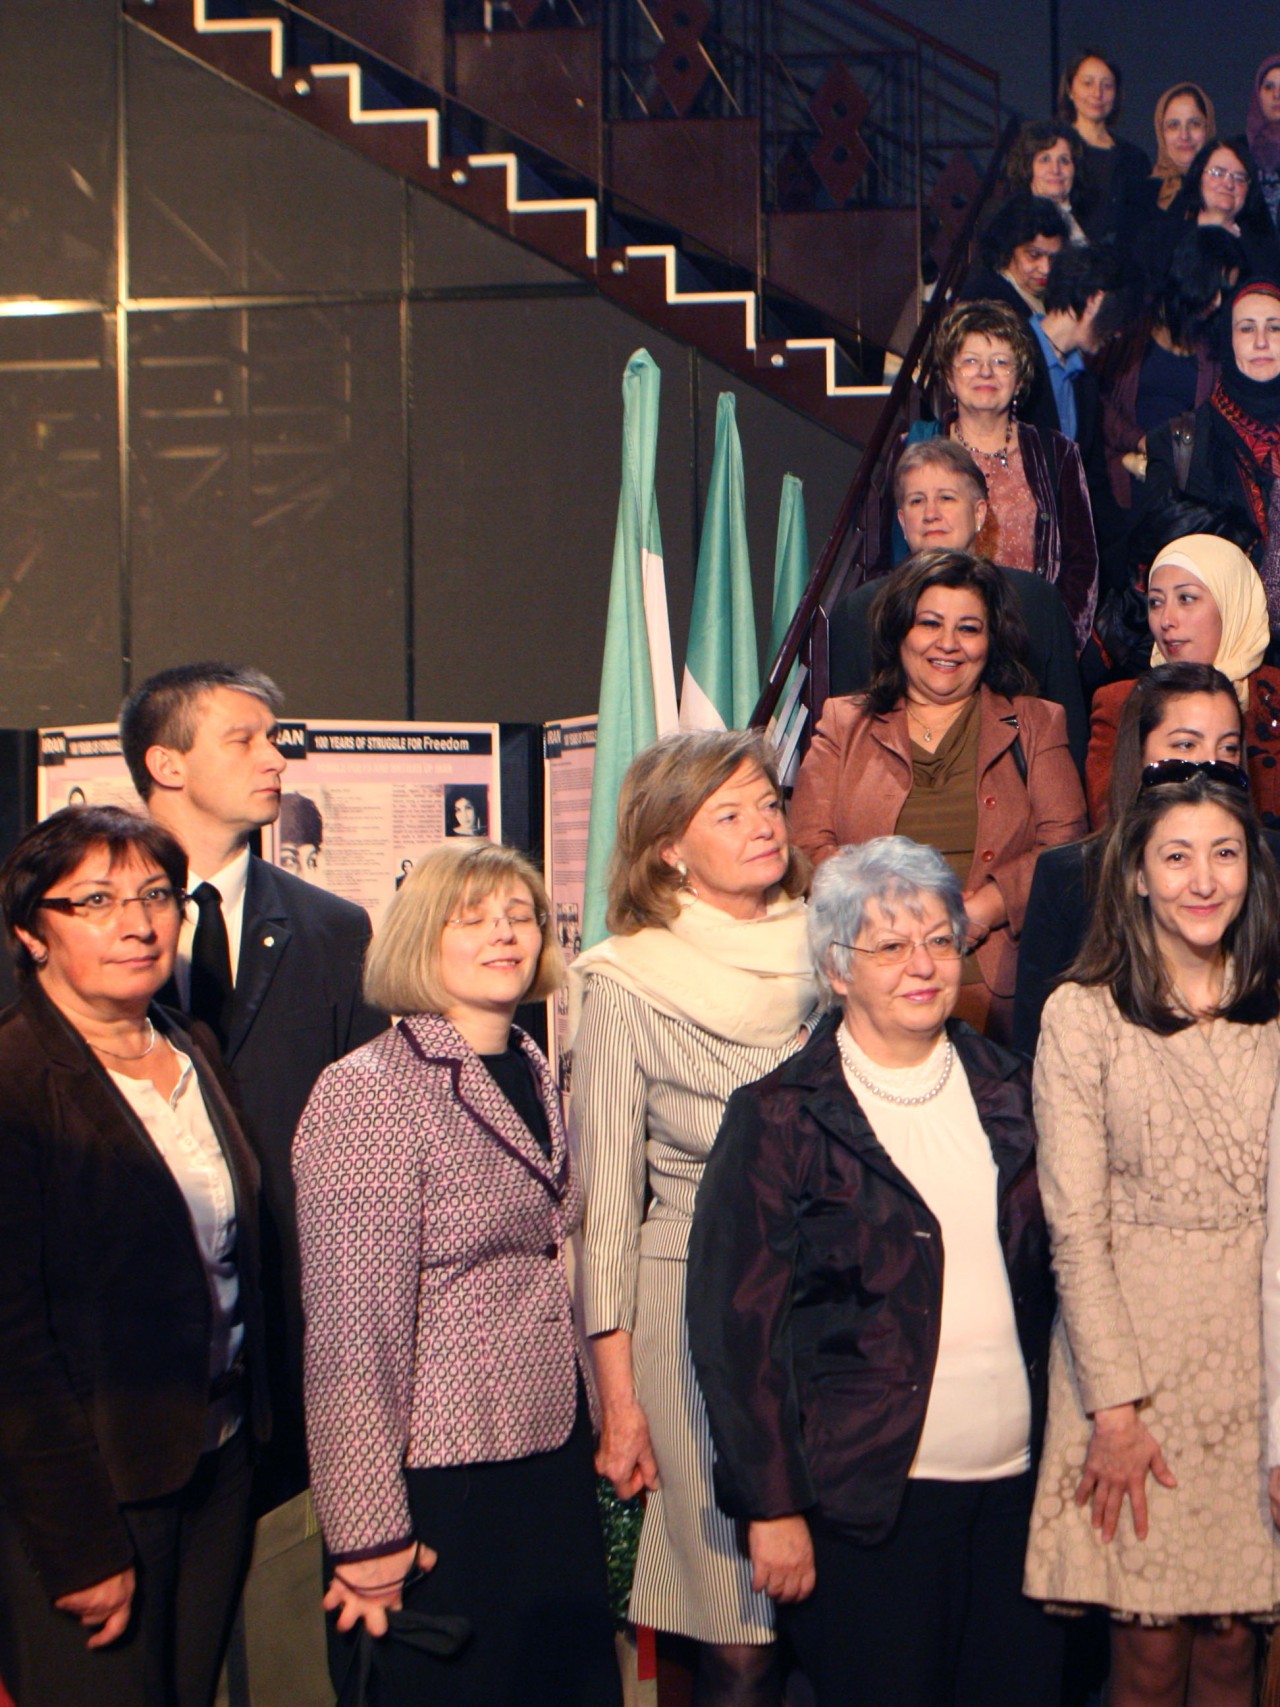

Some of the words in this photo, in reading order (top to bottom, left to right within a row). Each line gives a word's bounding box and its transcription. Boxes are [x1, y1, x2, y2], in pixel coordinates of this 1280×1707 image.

[329, 735, 355, 750] YEARS
[356, 736, 367, 750] OF
[407, 737, 423, 751] FOR
[423, 734, 470, 751] Freedom
